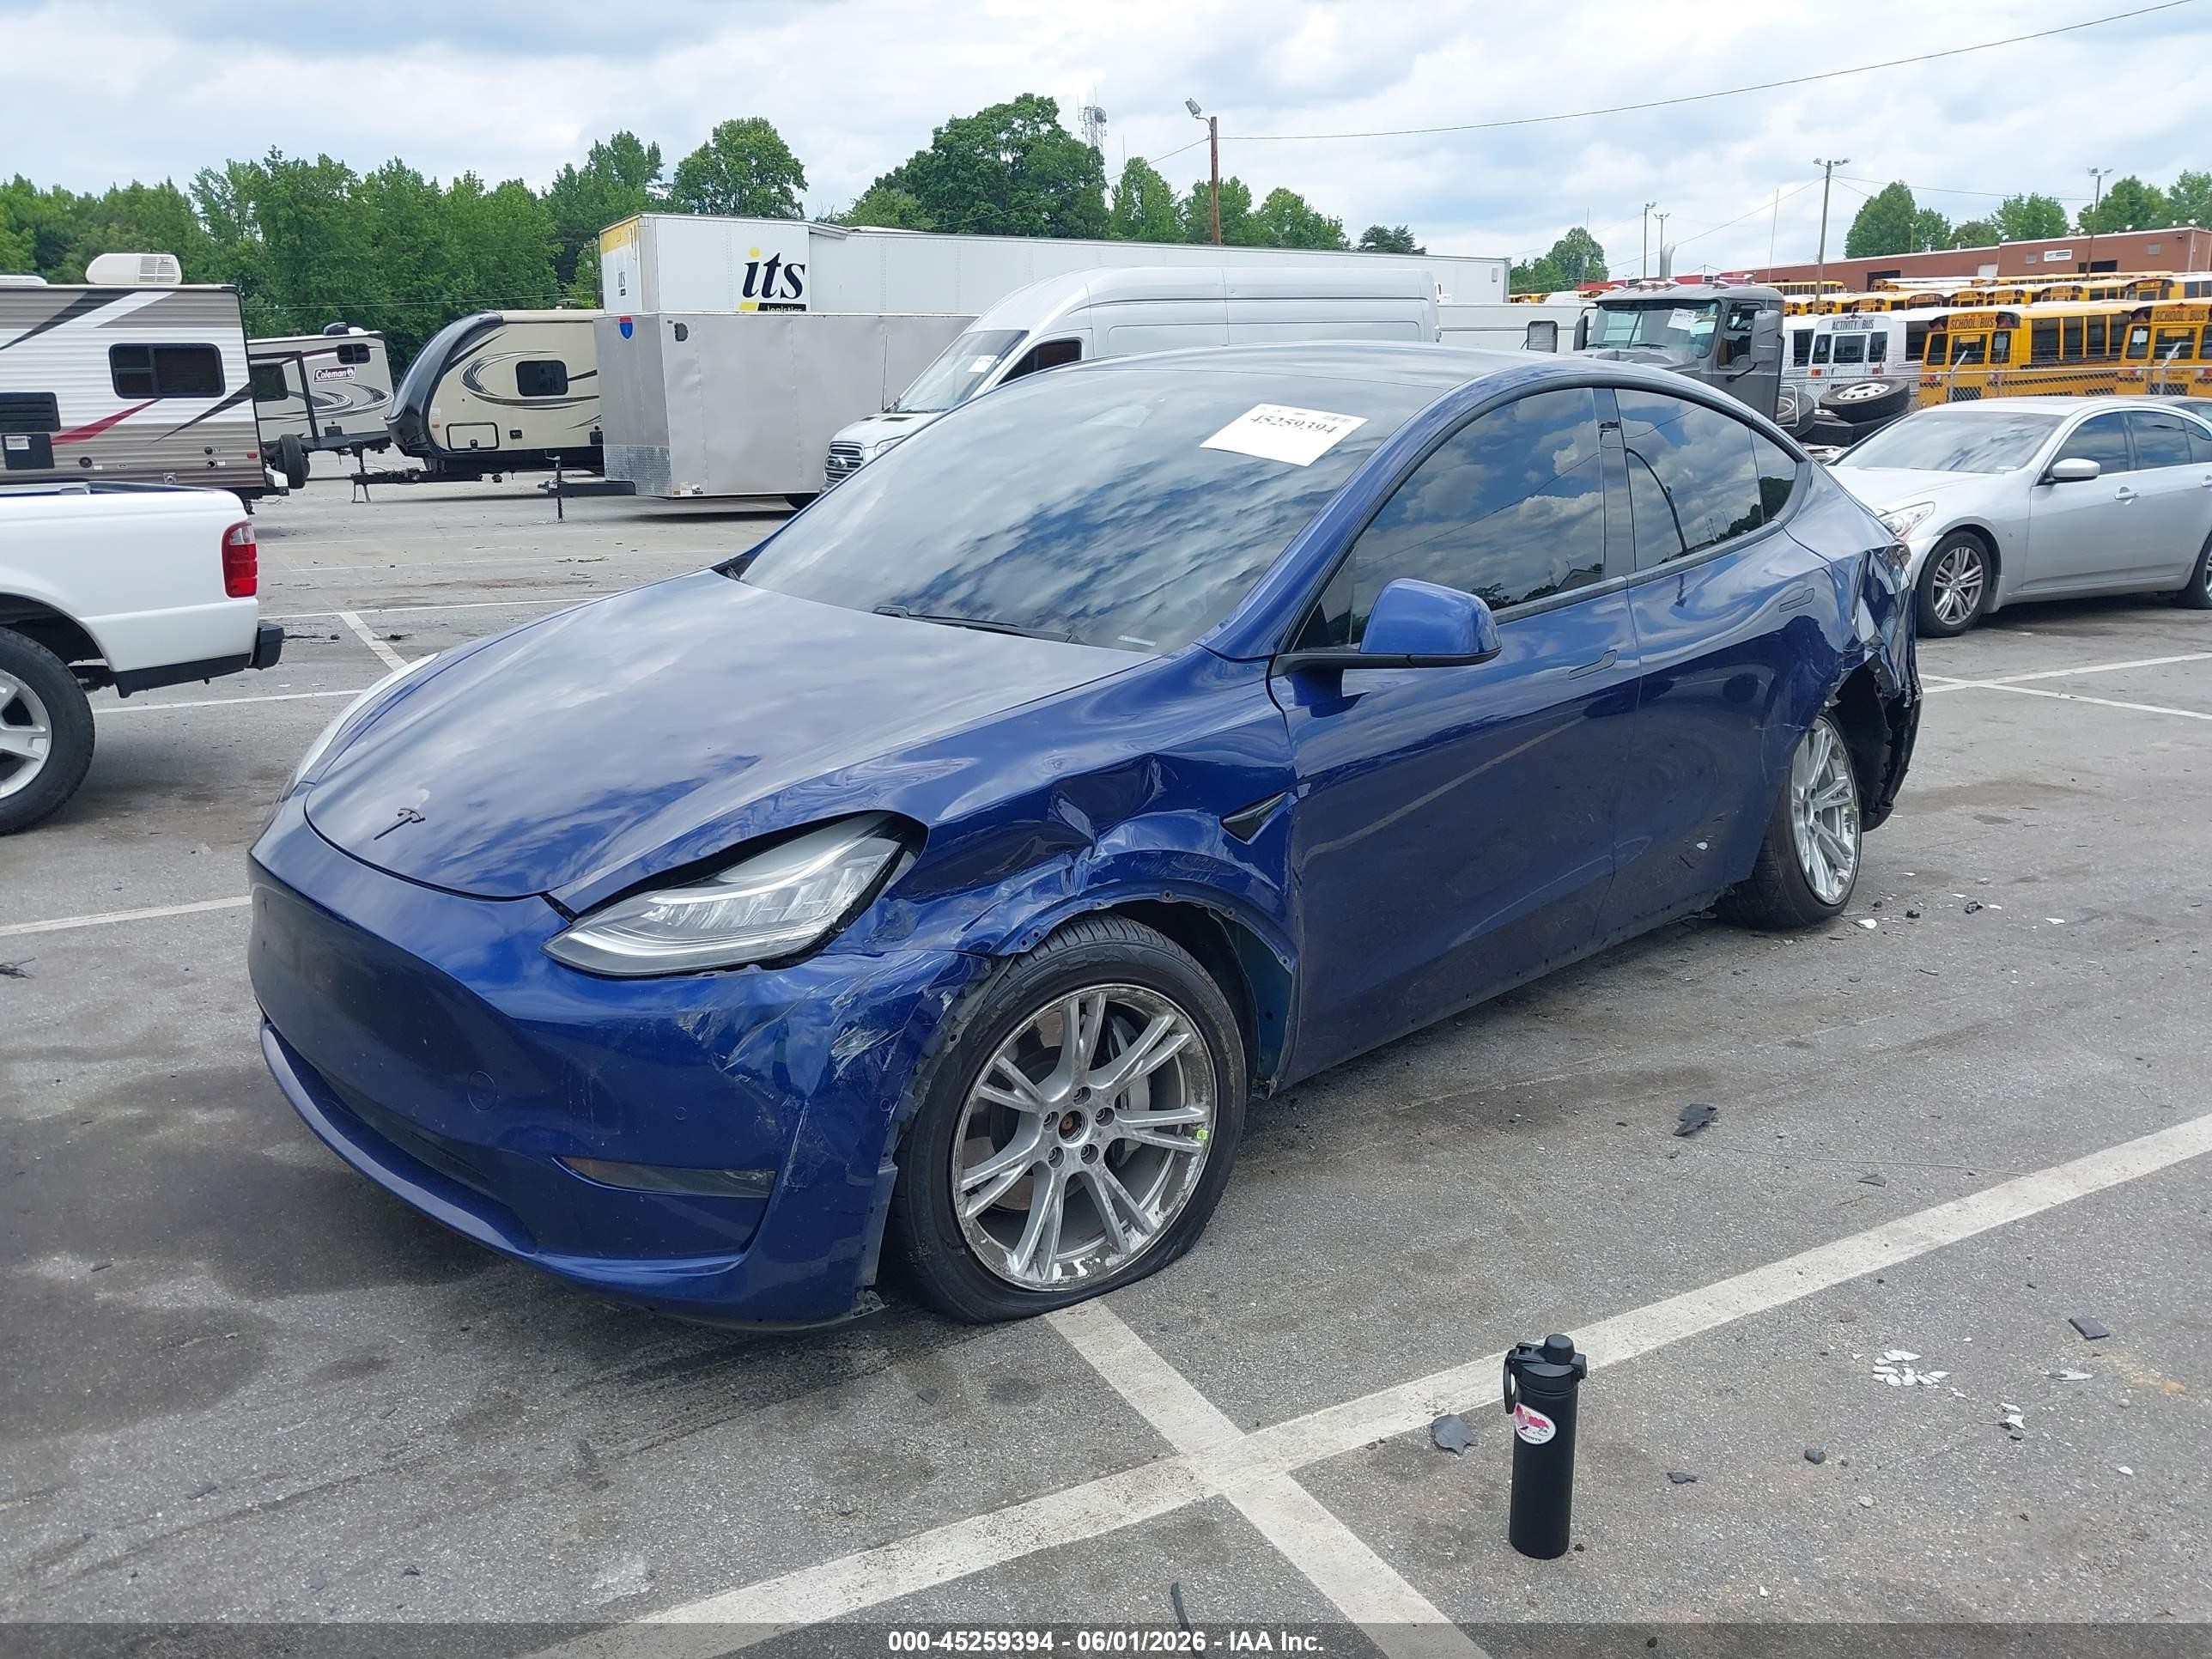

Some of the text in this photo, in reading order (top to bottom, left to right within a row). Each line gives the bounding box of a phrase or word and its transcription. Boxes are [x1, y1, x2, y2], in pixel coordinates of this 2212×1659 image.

[742, 246, 805, 300] its
[2155, 309, 2205, 322] SCHOOL BUS
[1832, 319, 1874, 331] ACTIVITY BUS
[1950, 317, 1995, 330] SCHOOL BUS
[315, 369, 346, 380] Coleman
[1250, 415, 1338, 434] 45259394
